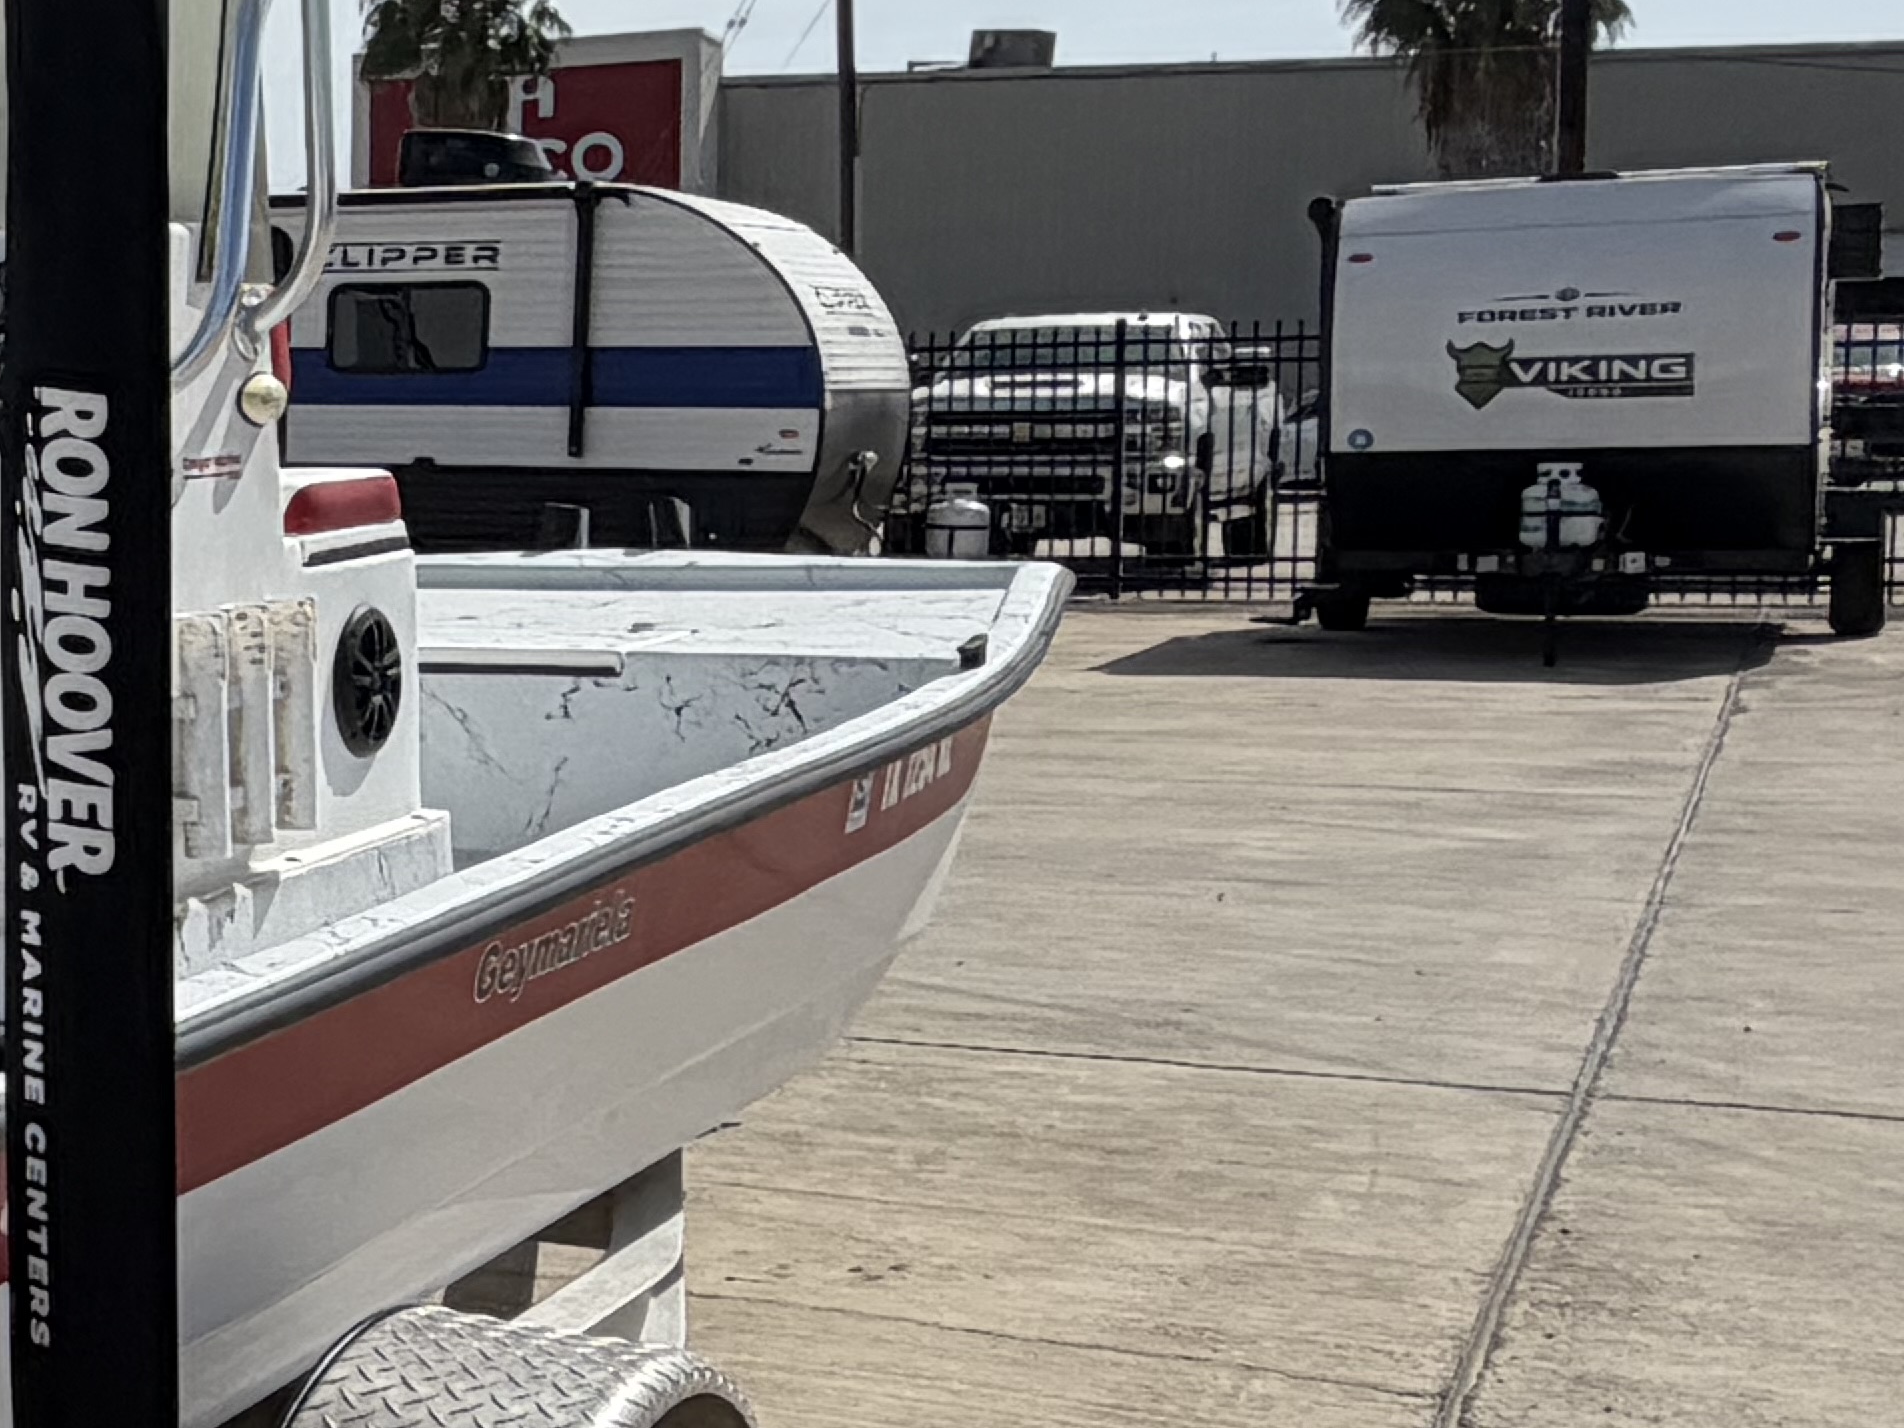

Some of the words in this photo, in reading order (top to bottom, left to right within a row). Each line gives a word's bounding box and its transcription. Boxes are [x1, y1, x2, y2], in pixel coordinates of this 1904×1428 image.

[1457, 307, 1579, 324] FOREST
[1586, 301, 1682, 319] RIVER
[1508, 357, 1688, 382] VIKING
[34, 386, 111, 553] RON
[42, 557, 116, 878] HOOVER
[17, 782, 39, 850] RV
[19, 860, 40, 892] &
[20, 908, 46, 1105] MARINE
[24, 1121, 50, 1349] CENTERS
